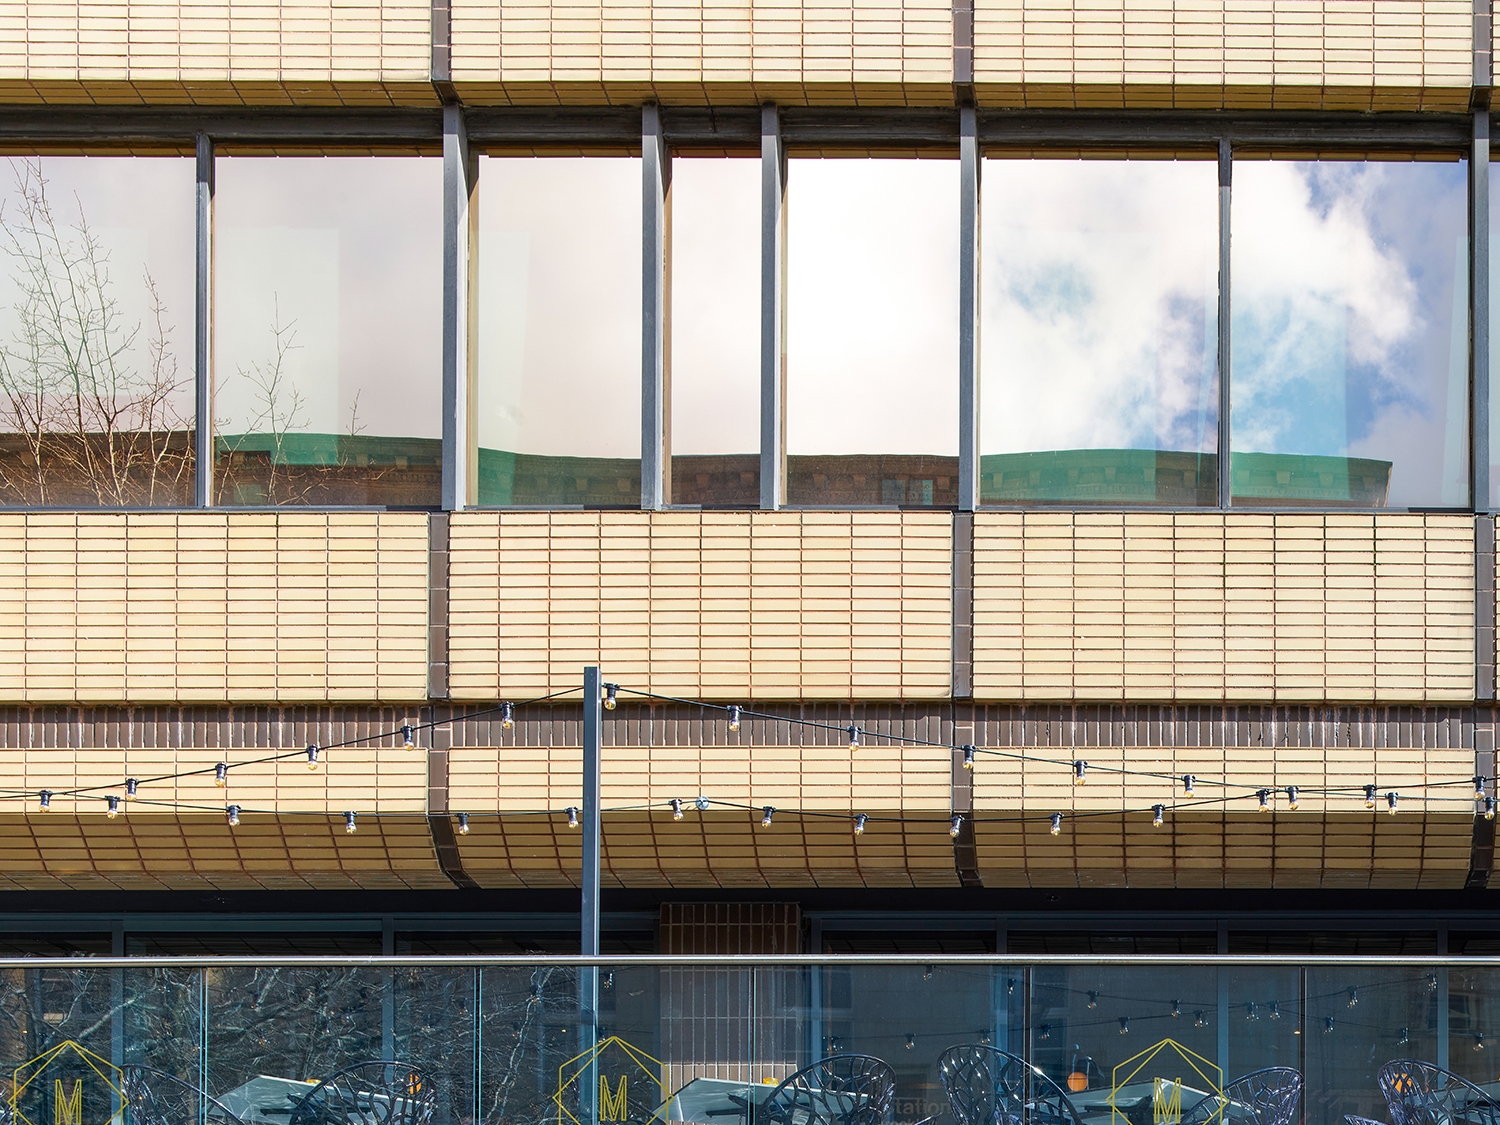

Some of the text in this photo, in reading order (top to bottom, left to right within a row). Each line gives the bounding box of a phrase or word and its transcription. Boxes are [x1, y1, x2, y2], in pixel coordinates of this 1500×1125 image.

[54, 1078, 82, 1125] M
[600, 1075, 627, 1122] M
[1154, 1078, 1182, 1124] M
